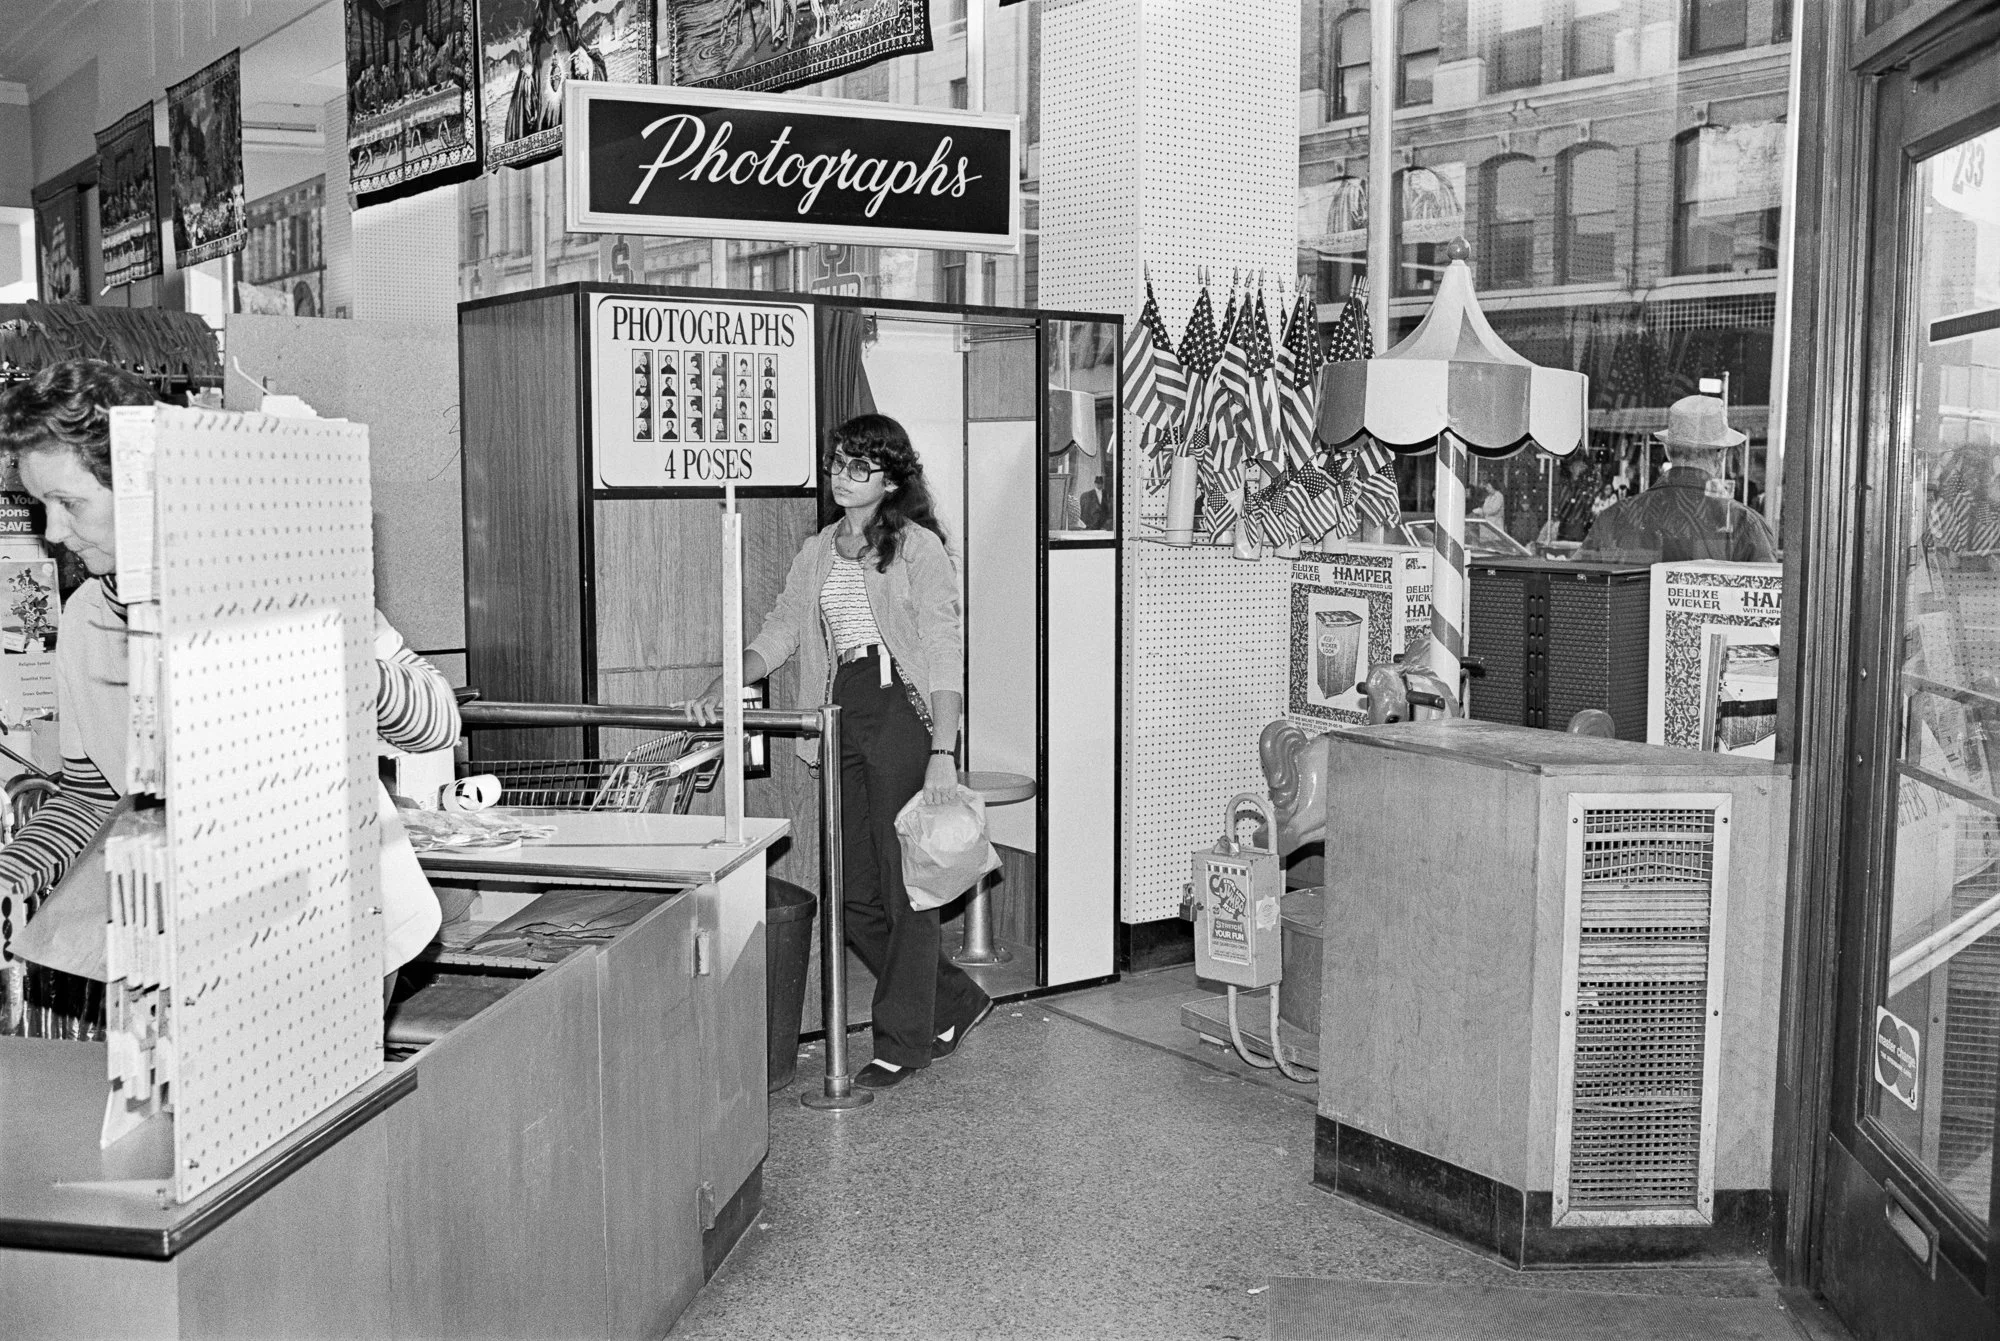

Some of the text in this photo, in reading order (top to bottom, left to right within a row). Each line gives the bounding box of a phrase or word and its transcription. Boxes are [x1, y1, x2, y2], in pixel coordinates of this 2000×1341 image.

[628, 113, 983, 218] Photographs
[612, 305, 795, 347] PHOTOGRAPHS
[664, 449, 753, 480] 4 POSES
[0, 521, 32, 532] SAVE
[1291, 563, 1393, 585] ELUXE HAMPER
[1406, 585, 1433, 594] DELU
[1406, 594, 1431, 603] WICK
[1668, 587, 1781, 609] DELUXE HA
[1668, 598, 1721, 610] WICKER
[1219, 883, 1245, 913] JUMBO
[1214, 929, 1245, 941] YOUR FUN
